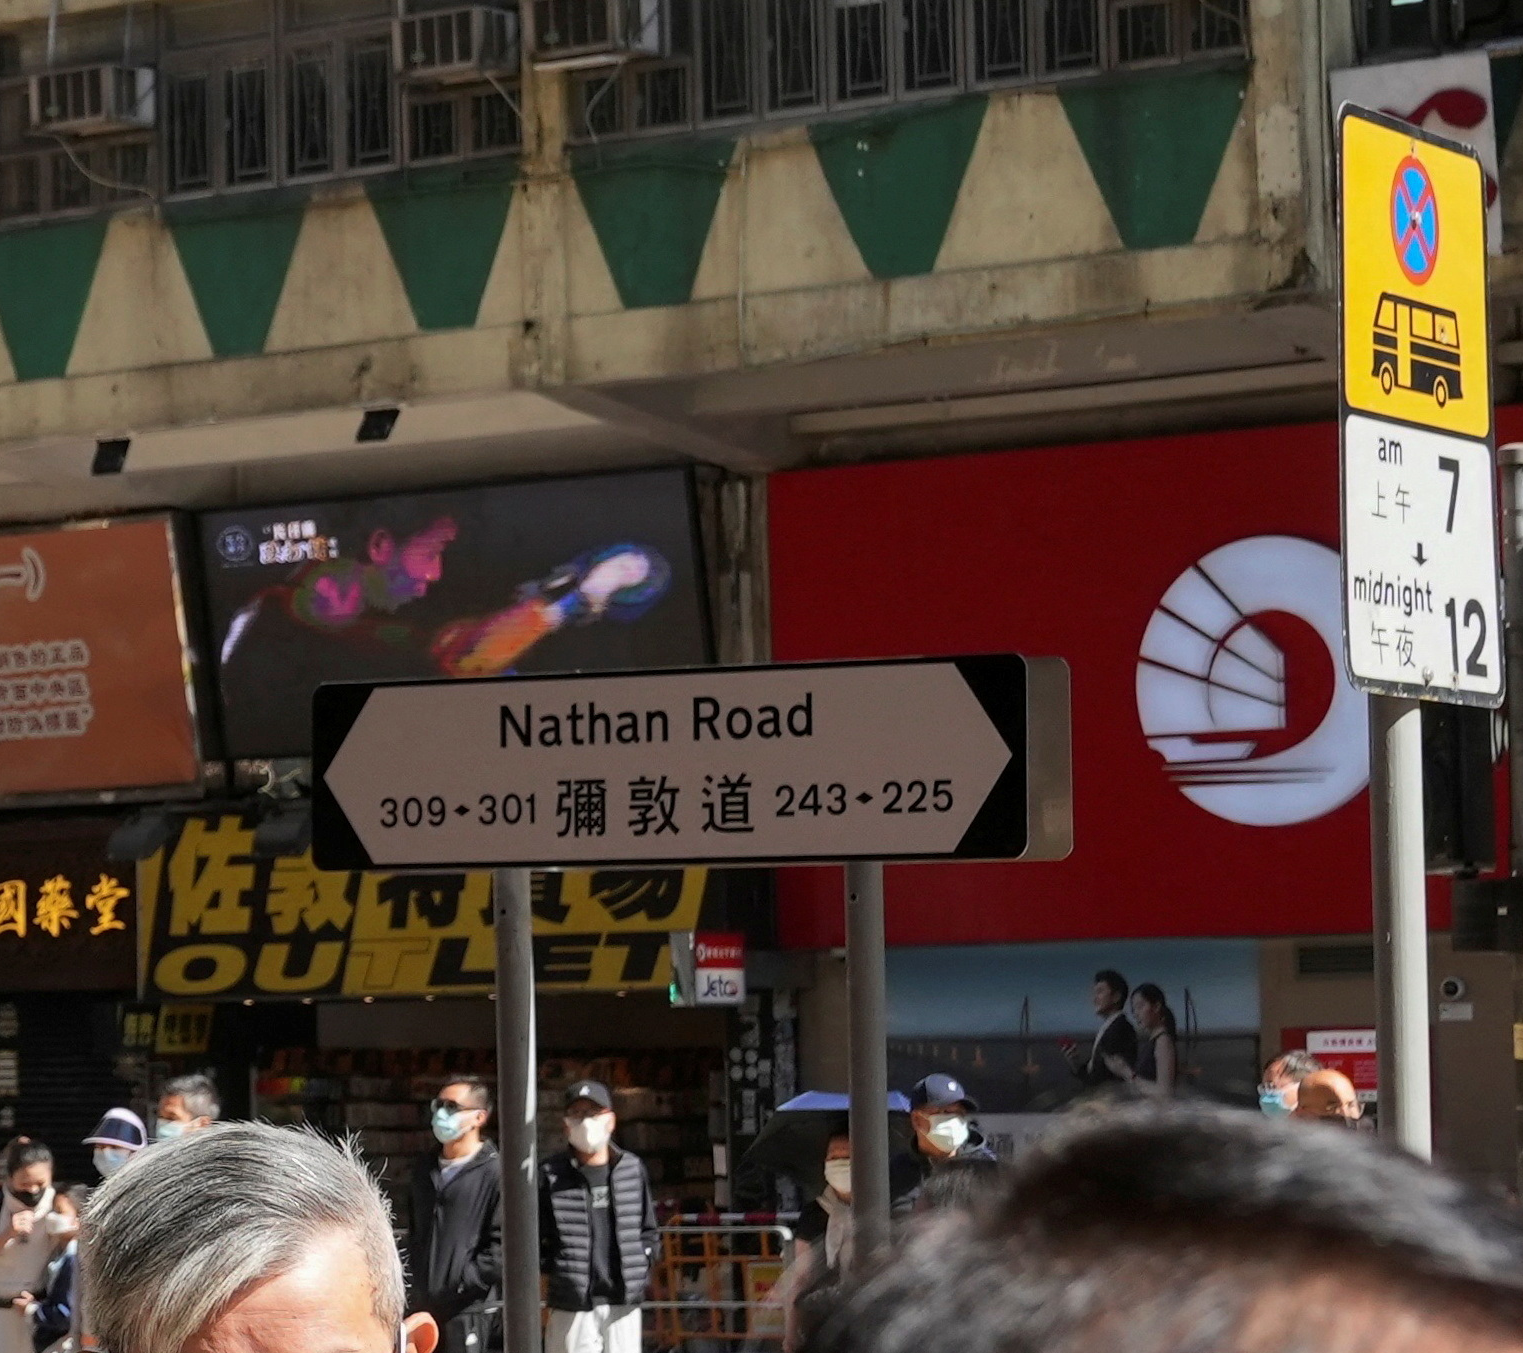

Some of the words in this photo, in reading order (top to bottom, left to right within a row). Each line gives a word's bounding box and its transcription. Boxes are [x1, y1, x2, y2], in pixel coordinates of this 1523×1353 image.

[1371, 480, 1411, 524] 上午
[1378, 437, 1403, 466] am
[1438, 456, 1460, 535] 7
[1354, 570, 1433, 617] midnight
[1445, 597, 1488, 678] 12
[1371, 621, 1416, 668] 午夜
[499, 701, 670, 748] Nathan
[692, 693, 814, 742] Road
[380, 796, 446, 828] 309
[479, 793, 538, 826] 301
[556, 773, 755, 838] 彌敦道
[775, 784, 847, 818] 243
[882, 779, 954, 815] 225
